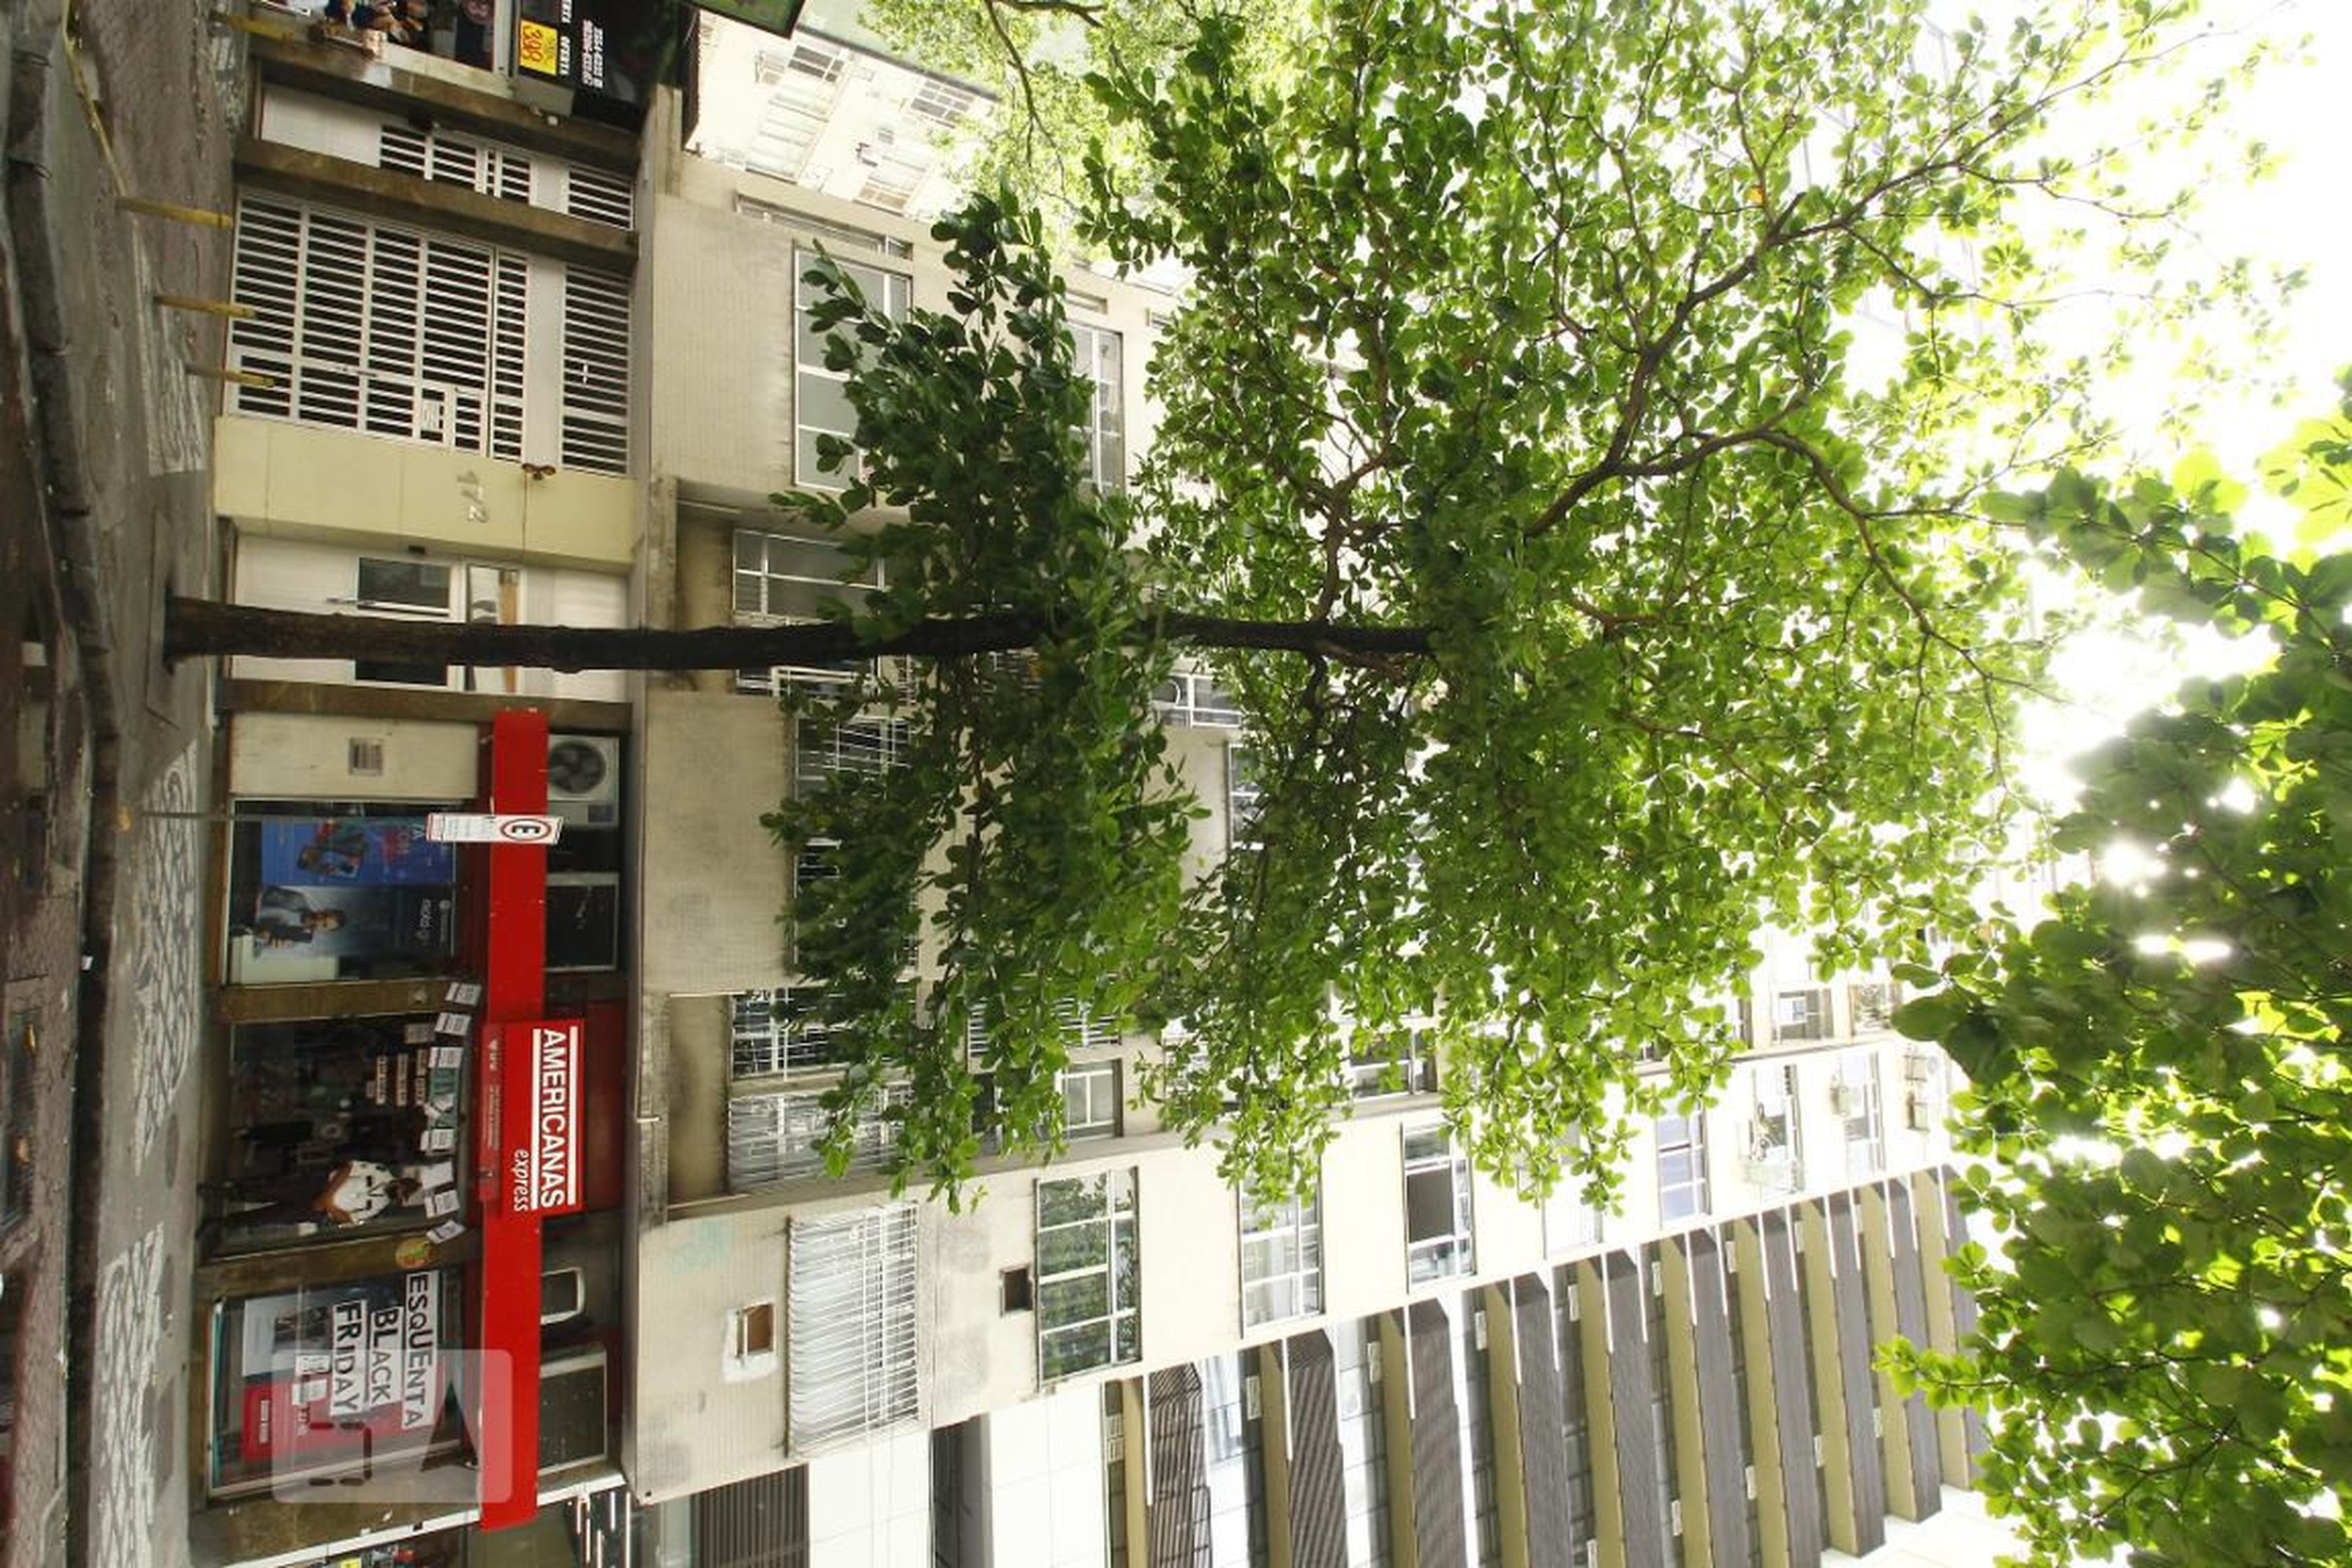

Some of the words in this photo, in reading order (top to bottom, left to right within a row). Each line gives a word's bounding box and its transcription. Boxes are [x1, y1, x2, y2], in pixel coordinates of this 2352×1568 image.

[560, 36, 570, 75] OFERTA
[512, 825, 541, 834] E
[541, 1029, 567, 1207] AMERICANAS
[511, 1149, 530, 1212] express
[333, 1303, 362, 1411] FRIDAY
[371, 1309, 400, 1405] BLACK
[405, 1274, 434, 1427] ESQUENTA
